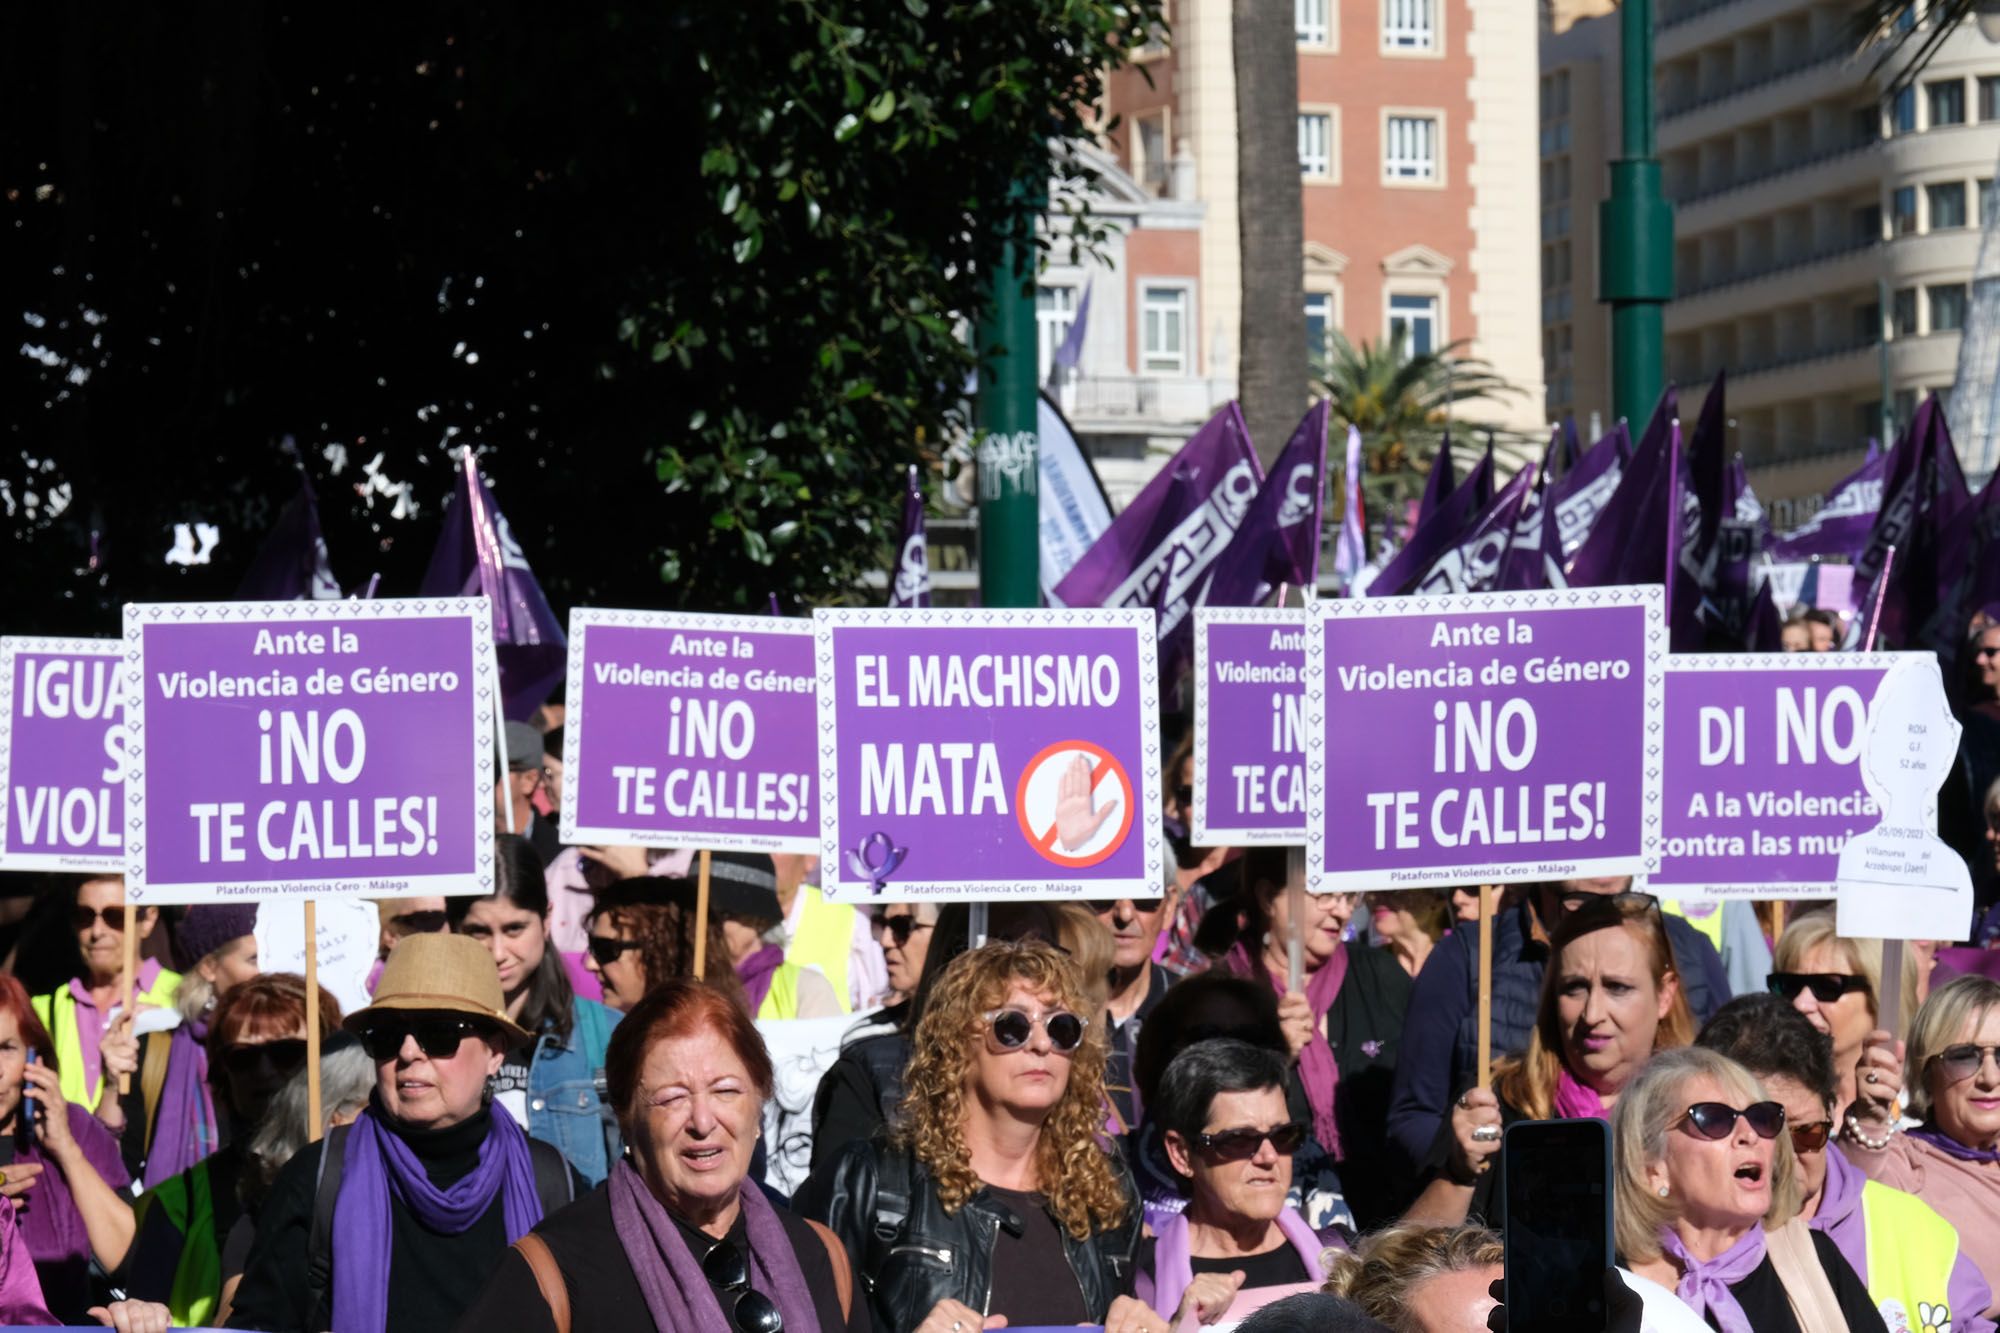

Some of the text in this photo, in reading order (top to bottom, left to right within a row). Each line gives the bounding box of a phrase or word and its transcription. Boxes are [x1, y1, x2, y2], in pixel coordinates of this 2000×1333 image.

[253, 626, 360, 656] Ante la
[669, 633, 754, 659] Ante la
[1430, 617, 1533, 648] Ante la
[22, 657, 125, 720] IGUA
[157, 666, 459, 699] Violencia de Género
[593, 662, 816, 694] Violencia de Géner
[855, 654, 1121, 708] EL MACHISMO
[1215, 660, 1297, 683] Violencia
[1337, 660, 1472, 692] Violencia
[1480, 659, 1518, 686] de
[1523, 656, 1630, 684] Género
[668, 696, 755, 761] ¡NO
[1433, 697, 1538, 773] ¡NO
[1699, 685, 1866, 767] DI NO
[258, 708, 366, 785] ¡NO
[612, 765, 810, 823] TE CALLES!
[860, 742, 1009, 816] MATA
[1232, 764, 1306, 814] TE CA
[14, 786, 123, 847] VIOL
[1366, 781, 1606, 850] TE CALLES!
[1687, 788, 1880, 818] A la Violencia
[189, 795, 438, 863] TE CALLES!
[630, 832, 678, 842] Plataforma
[681, 835, 721, 844] Violencia
[1752, 829, 1792, 856] las
[216, 885, 278, 895] Plataforma
[281, 883, 332, 893] Violencia
[334, 882, 360, 892] Cero
[368, 880, 409, 891] Málaga
[903, 884, 961, 894] Plataforma
[963, 883, 1011, 893] Violencia
[1013, 883, 1037, 893] Cero
[1045, 882, 1083, 893] Málaga
[1390, 871, 1450, 881] Plataforma
[1452, 867, 1501, 878] Violencia
[1503, 866, 1528, 876] Cero
[1537, 863, 1577, 874] Málaga
[1704, 886, 1755, 895] Plataforma
[1758, 886, 1799, 894] Violencia
[1801, 885, 1822, 893] Cero
